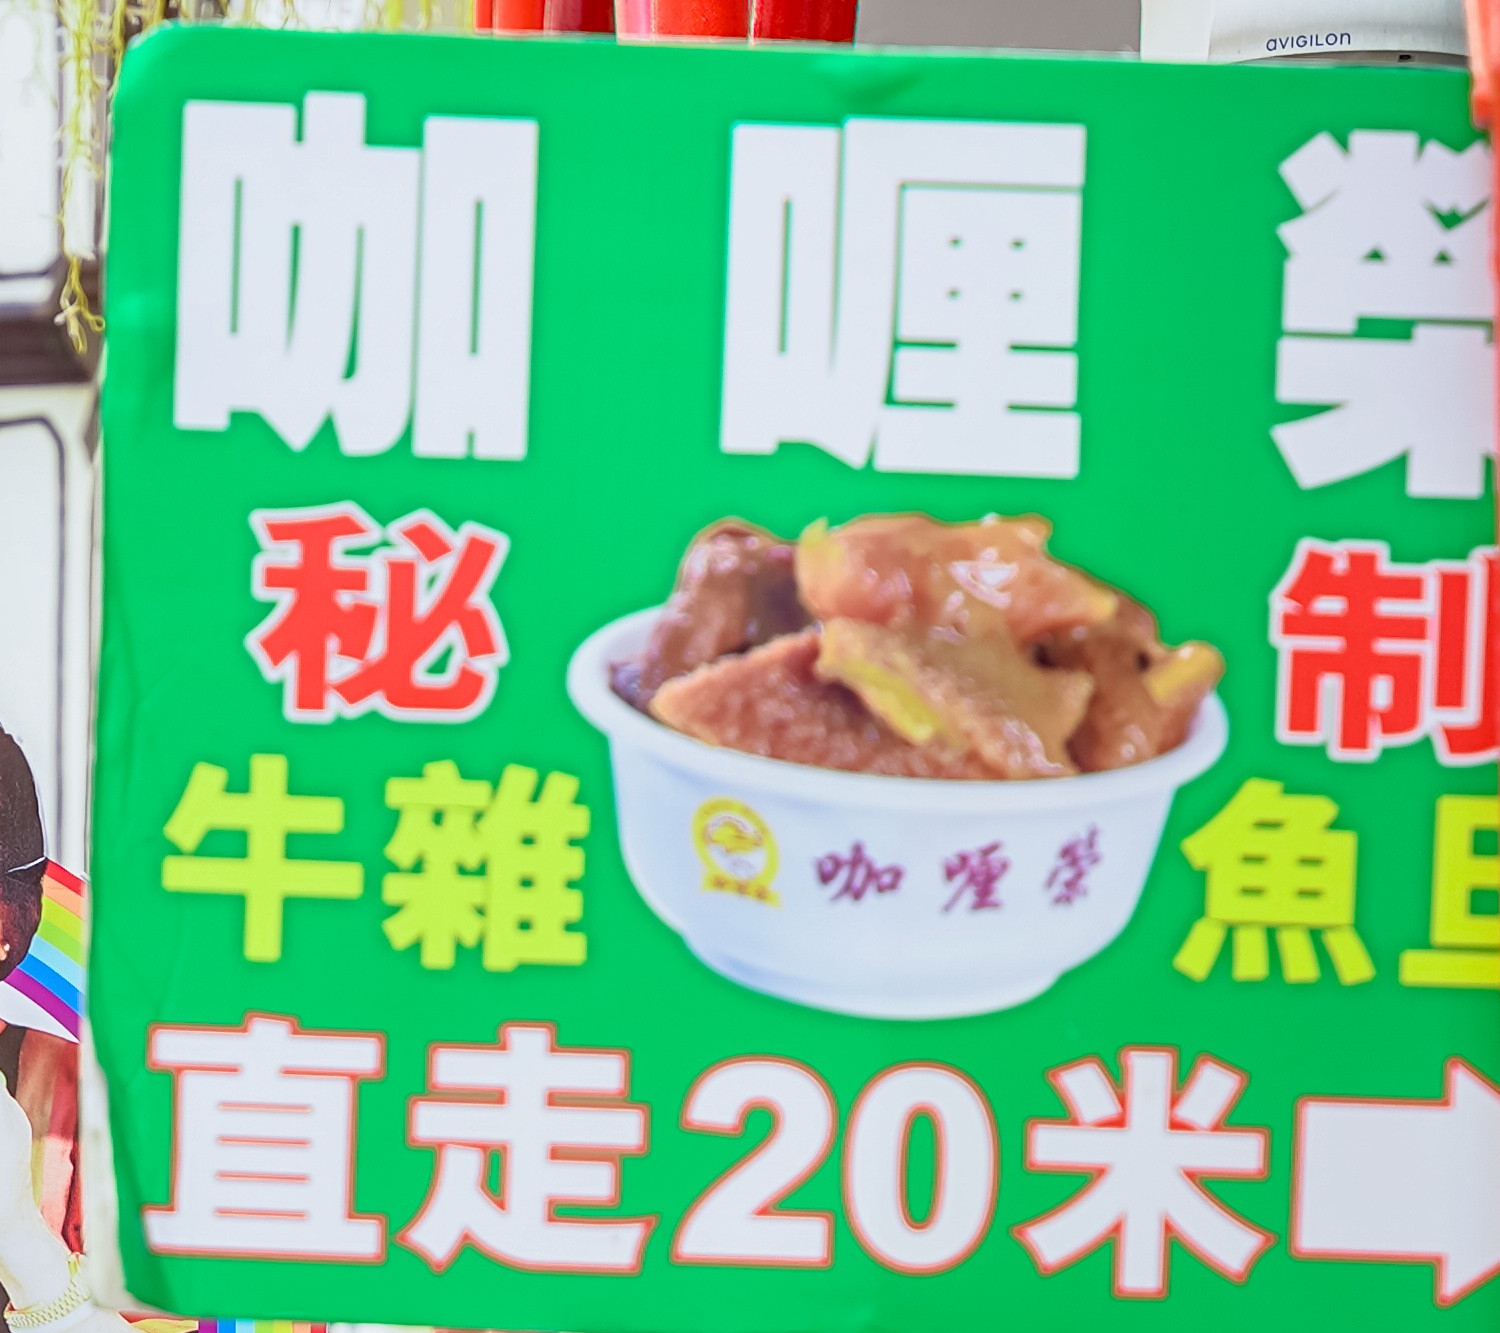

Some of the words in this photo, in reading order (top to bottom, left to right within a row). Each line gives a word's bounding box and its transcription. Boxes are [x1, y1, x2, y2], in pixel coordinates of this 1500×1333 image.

[161, 753, 591, 972] 牛雜
[143, 1010, 1276, 1303] 直走20米
